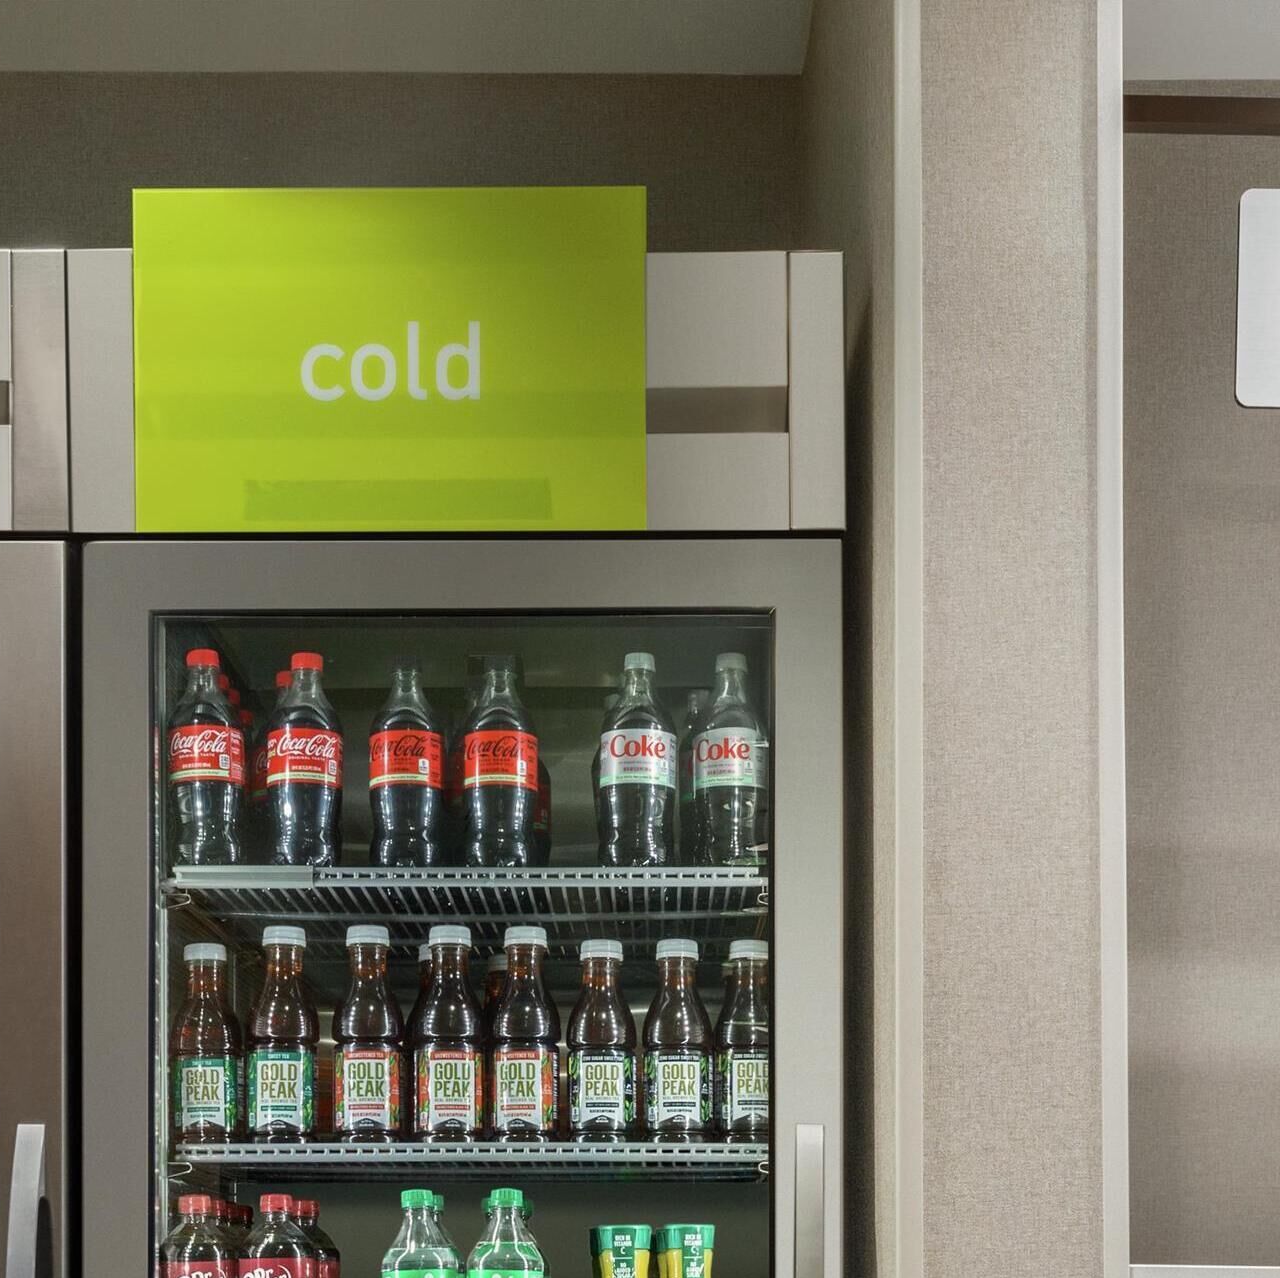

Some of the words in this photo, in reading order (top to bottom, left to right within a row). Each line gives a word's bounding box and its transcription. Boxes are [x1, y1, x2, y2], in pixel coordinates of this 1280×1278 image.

[299, 322, 483, 401] cold
[609, 734, 668, 758] Coke
[696, 737, 751, 763] Coke
[260, 1064, 297, 1080] GOLD
[348, 1063, 384, 1079] GOLD
[500, 1063, 536, 1080] GOLD
[585, 1064, 619, 1080] GOLD
[260, 1081, 297, 1098] PEAK
[348, 1081, 384, 1097] PEAK
[500, 1080, 536, 1097] PEAK
[585, 1081, 618, 1097] PEAK
